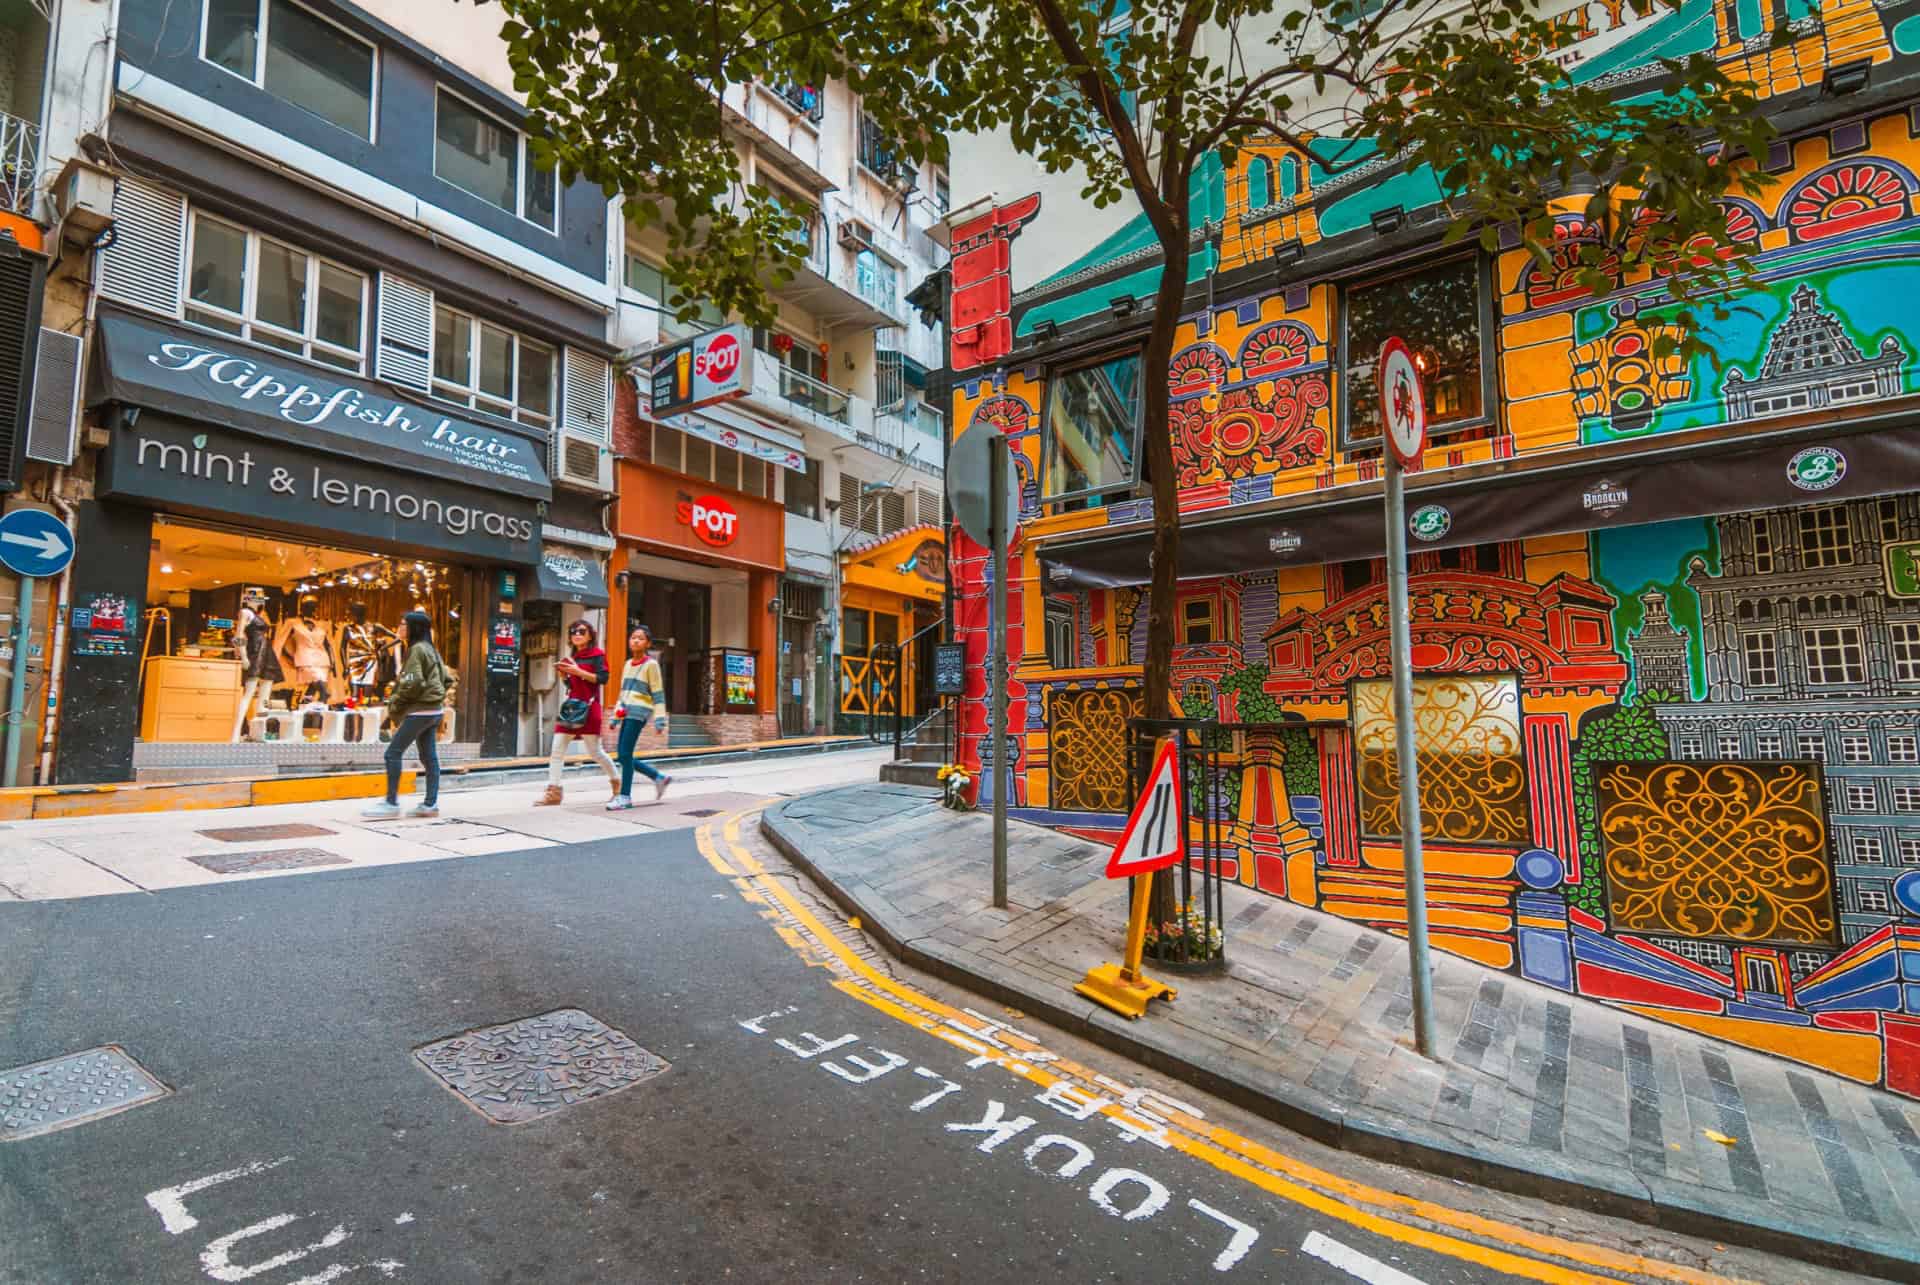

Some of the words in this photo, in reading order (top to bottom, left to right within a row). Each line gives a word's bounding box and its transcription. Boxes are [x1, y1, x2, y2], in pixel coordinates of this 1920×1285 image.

[696, 344, 738, 376] SPOT
[432, 418, 517, 458] hair
[138, 434, 255, 485] mint
[269, 467, 296, 495] &
[312, 467, 532, 540] lemongrass
[677, 502, 737, 535] SPOT
[738, 1006, 962, 1112] LEFT
[945, 1100, 1260, 1272] LOOK
